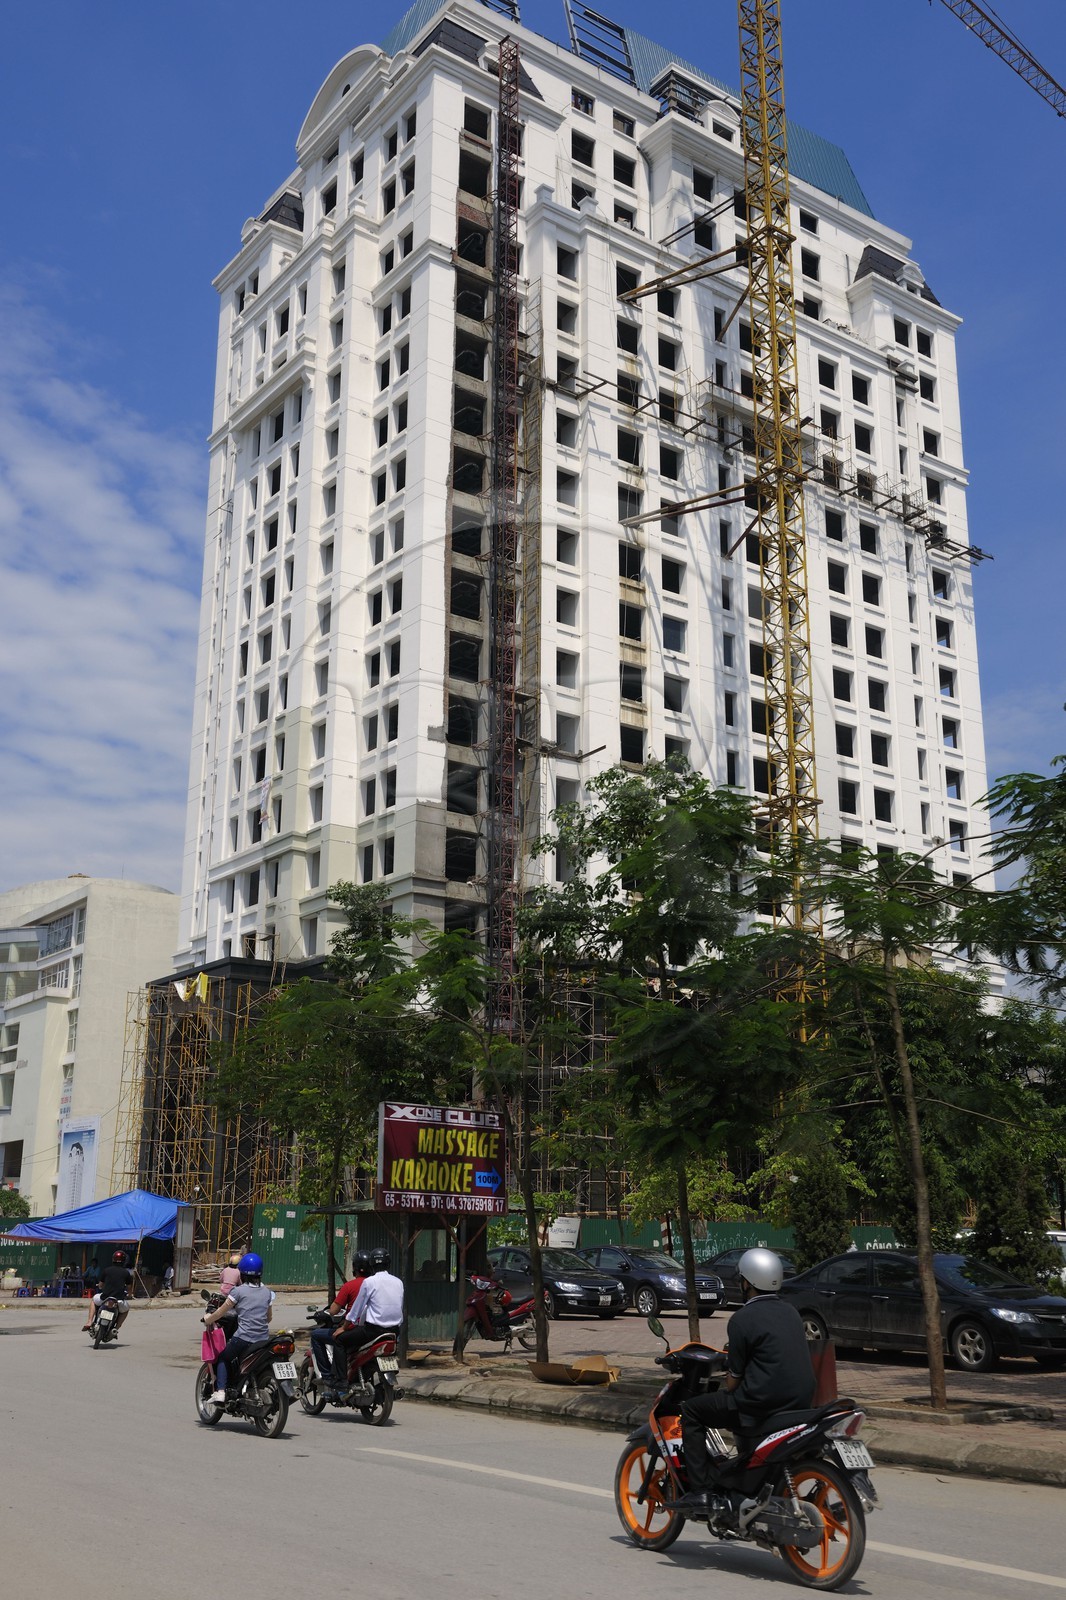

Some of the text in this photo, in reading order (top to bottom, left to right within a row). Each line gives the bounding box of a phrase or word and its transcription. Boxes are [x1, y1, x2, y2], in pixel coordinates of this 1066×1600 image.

[445, 1110, 499, 1127] CLUB
[417, 1128, 499, 1159] MASSAGE
[390, 1158, 473, 1193] KARAOKE
[477, 1175, 499, 1185] 100M
[385, 1194, 395, 1207] 65
[401, 1194, 425, 1208] 53TT4
[846, 1454, 871, 1467] 9300
